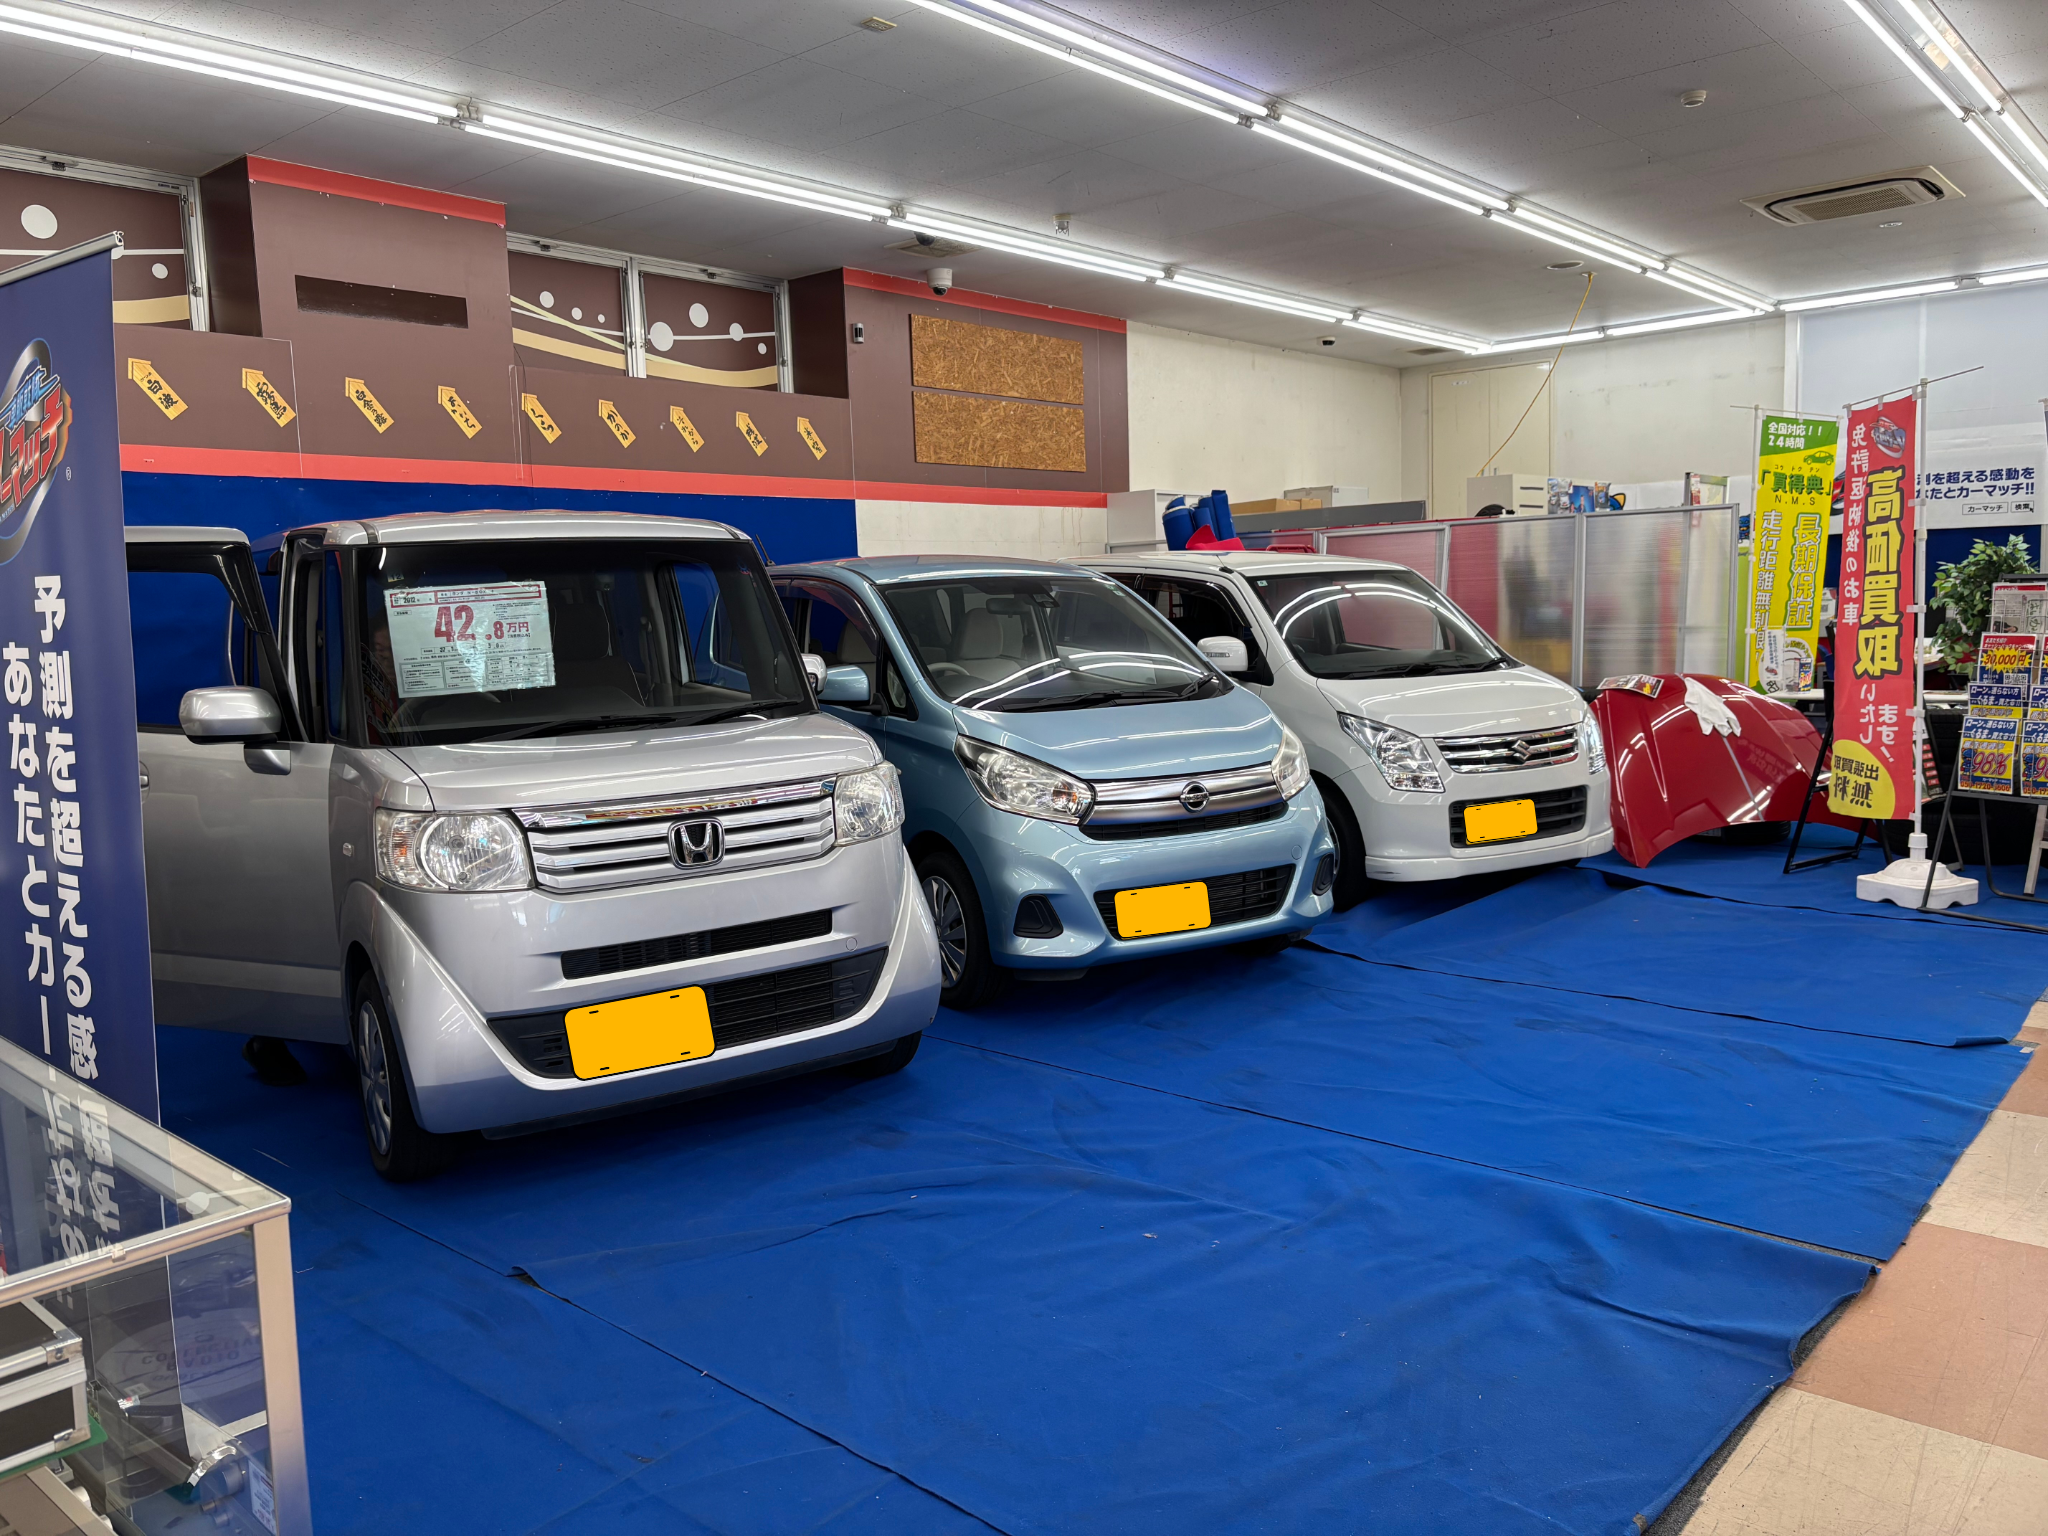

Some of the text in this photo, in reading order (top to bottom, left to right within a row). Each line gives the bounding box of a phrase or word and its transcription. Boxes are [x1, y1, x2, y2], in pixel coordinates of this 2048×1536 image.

[146, 379, 179, 410] 白波
[1787, 515, 1820, 628] 長期保証
[1972, 751, 2012, 777] 98%
[2, 641, 52, 1056] あなたとカー
[34, 575, 99, 1081] 予測を超える感
